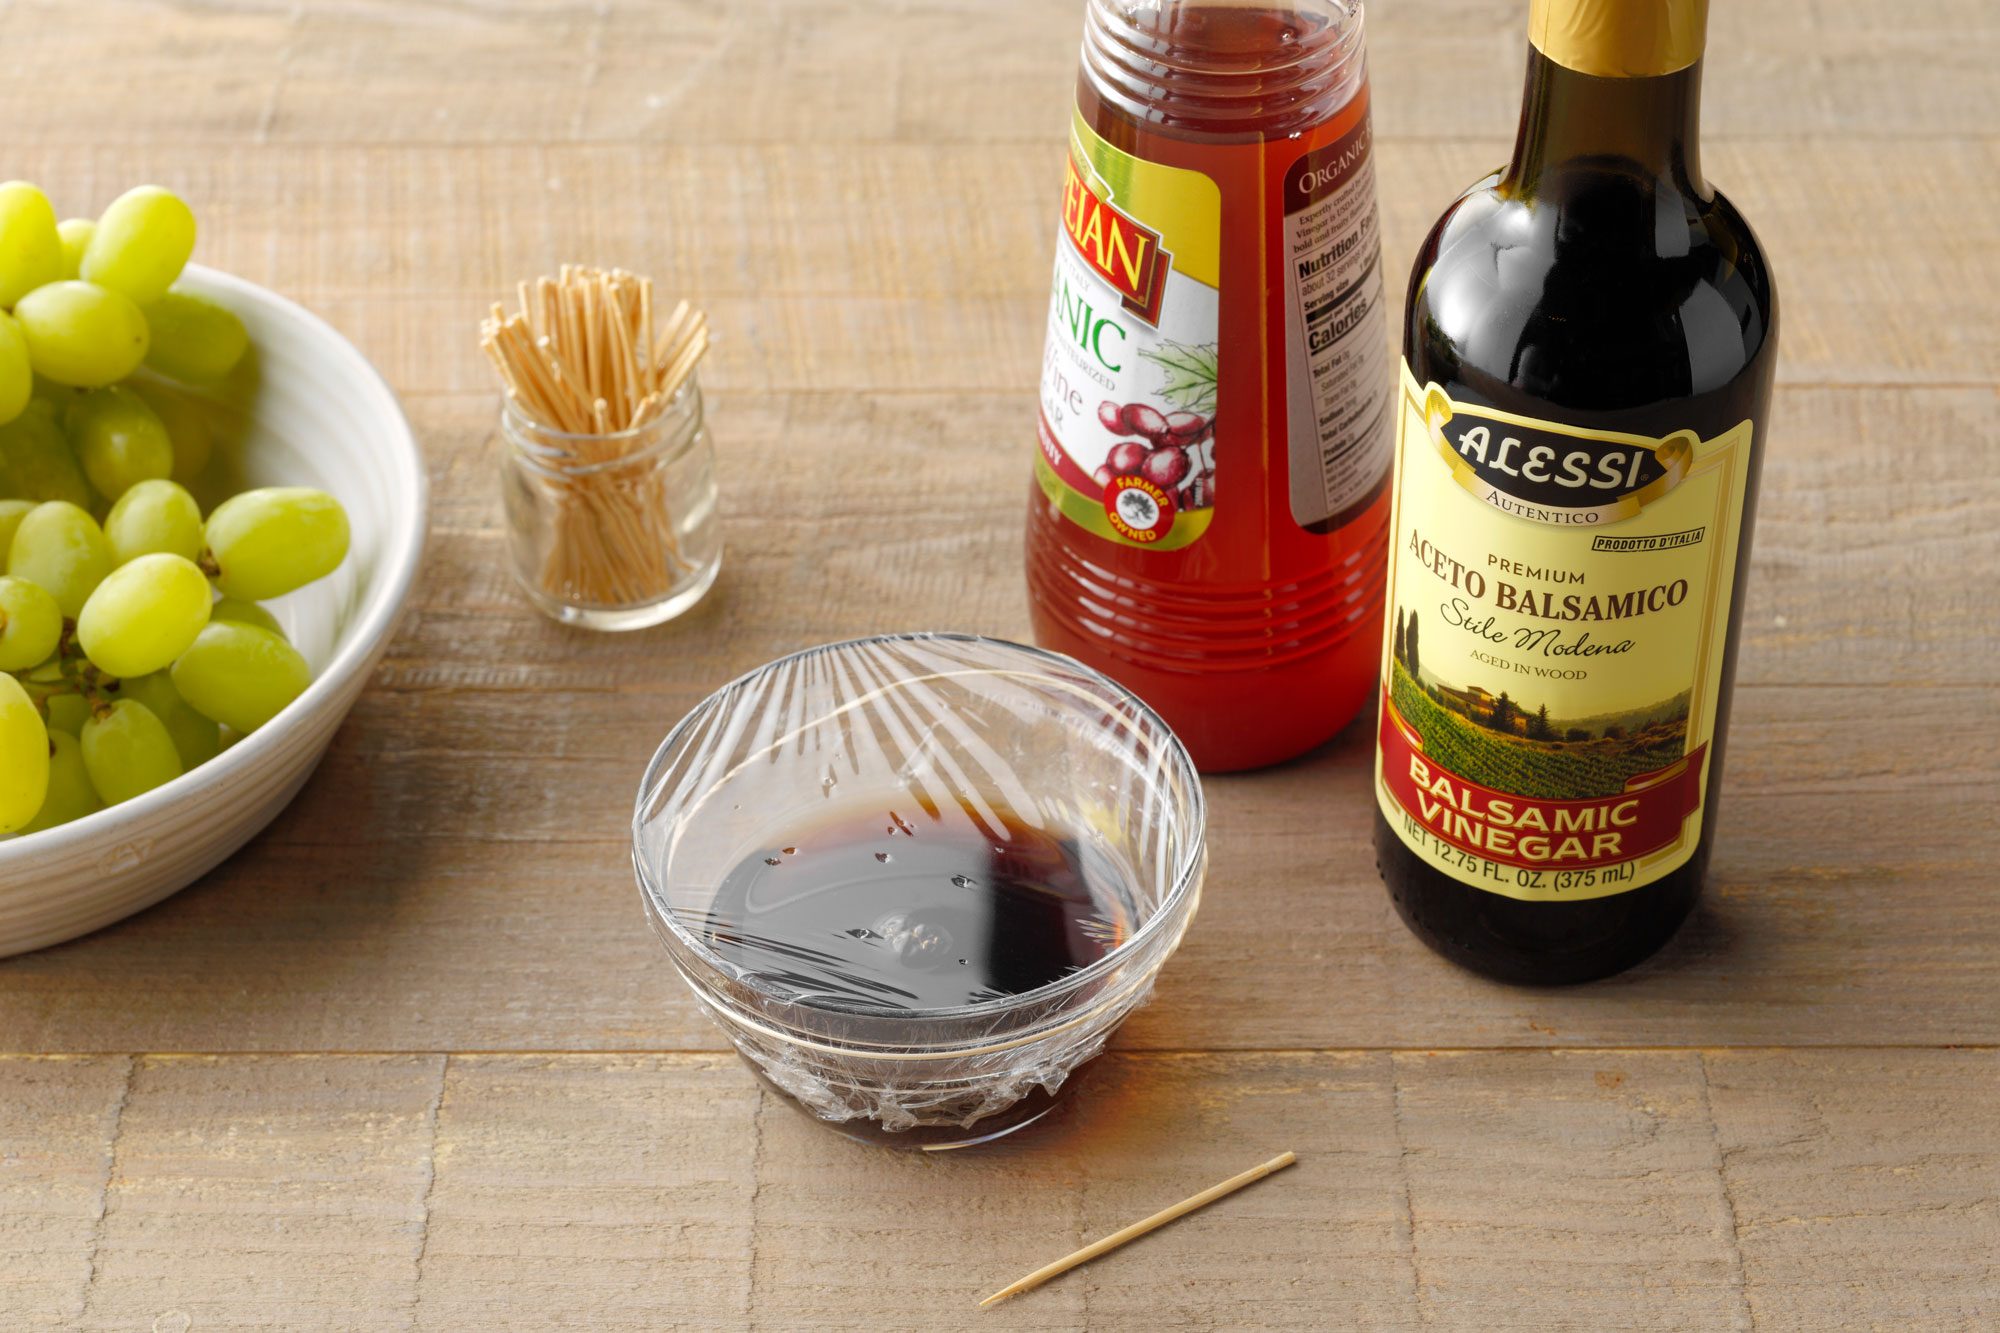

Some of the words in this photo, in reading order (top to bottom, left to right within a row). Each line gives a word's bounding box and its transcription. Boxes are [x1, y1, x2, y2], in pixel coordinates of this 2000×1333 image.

[1299, 131, 1366, 193] ORGANIC
[1065, 165, 1150, 292] EIAN
[1296, 217, 1328, 239] Vinegar
[1299, 200, 1332, 226] Expertly
[1293, 240, 1313, 254] bold
[1314, 230, 1330, 244] and
[1298, 230, 1359, 279] Nutrition
[1302, 276, 1325, 297] about
[1326, 269, 1336, 284] 32
[1304, 288, 1335, 311] Serving
[1335, 279, 1349, 292] size
[1308, 297, 1367, 351] Calories
[1312, 362, 1331, 380] Total
[1331, 354, 1342, 369] Fat
[1458, 425, 1645, 489] ALESSI
[1116, 476, 1169, 507] FARMER
[1486, 490, 1599, 524] AUTENTICO
[1109, 511, 1157, 542] OWNED
[1596, 538, 1656, 551] PRODOTTO
[1659, 530, 1701, 548] D'ITALIA
[1409, 529, 1486, 599] ACETO
[1495, 579, 1689, 622] BALSAMICO
[1488, 554, 1585, 585] PREMIUM
[1440, 597, 1509, 643] Stile
[1513, 627, 1636, 657] Modena
[1470, 649, 1510, 670] AGED
[1514, 662, 1532, 676] IN
[1534, 667, 1588, 680] WOOD
[1409, 753, 1640, 834] BALSAMIC
[1416, 788, 1624, 863] VINEGAR
[1403, 814, 1427, 847] NET
[1434, 838, 1478, 874] 12.75
[1483, 861, 1510, 884] FL.
[1517, 869, 1547, 888] OZ.
[1553, 870, 1596, 892] (375
[1602, 861, 1635, 883] mL)
